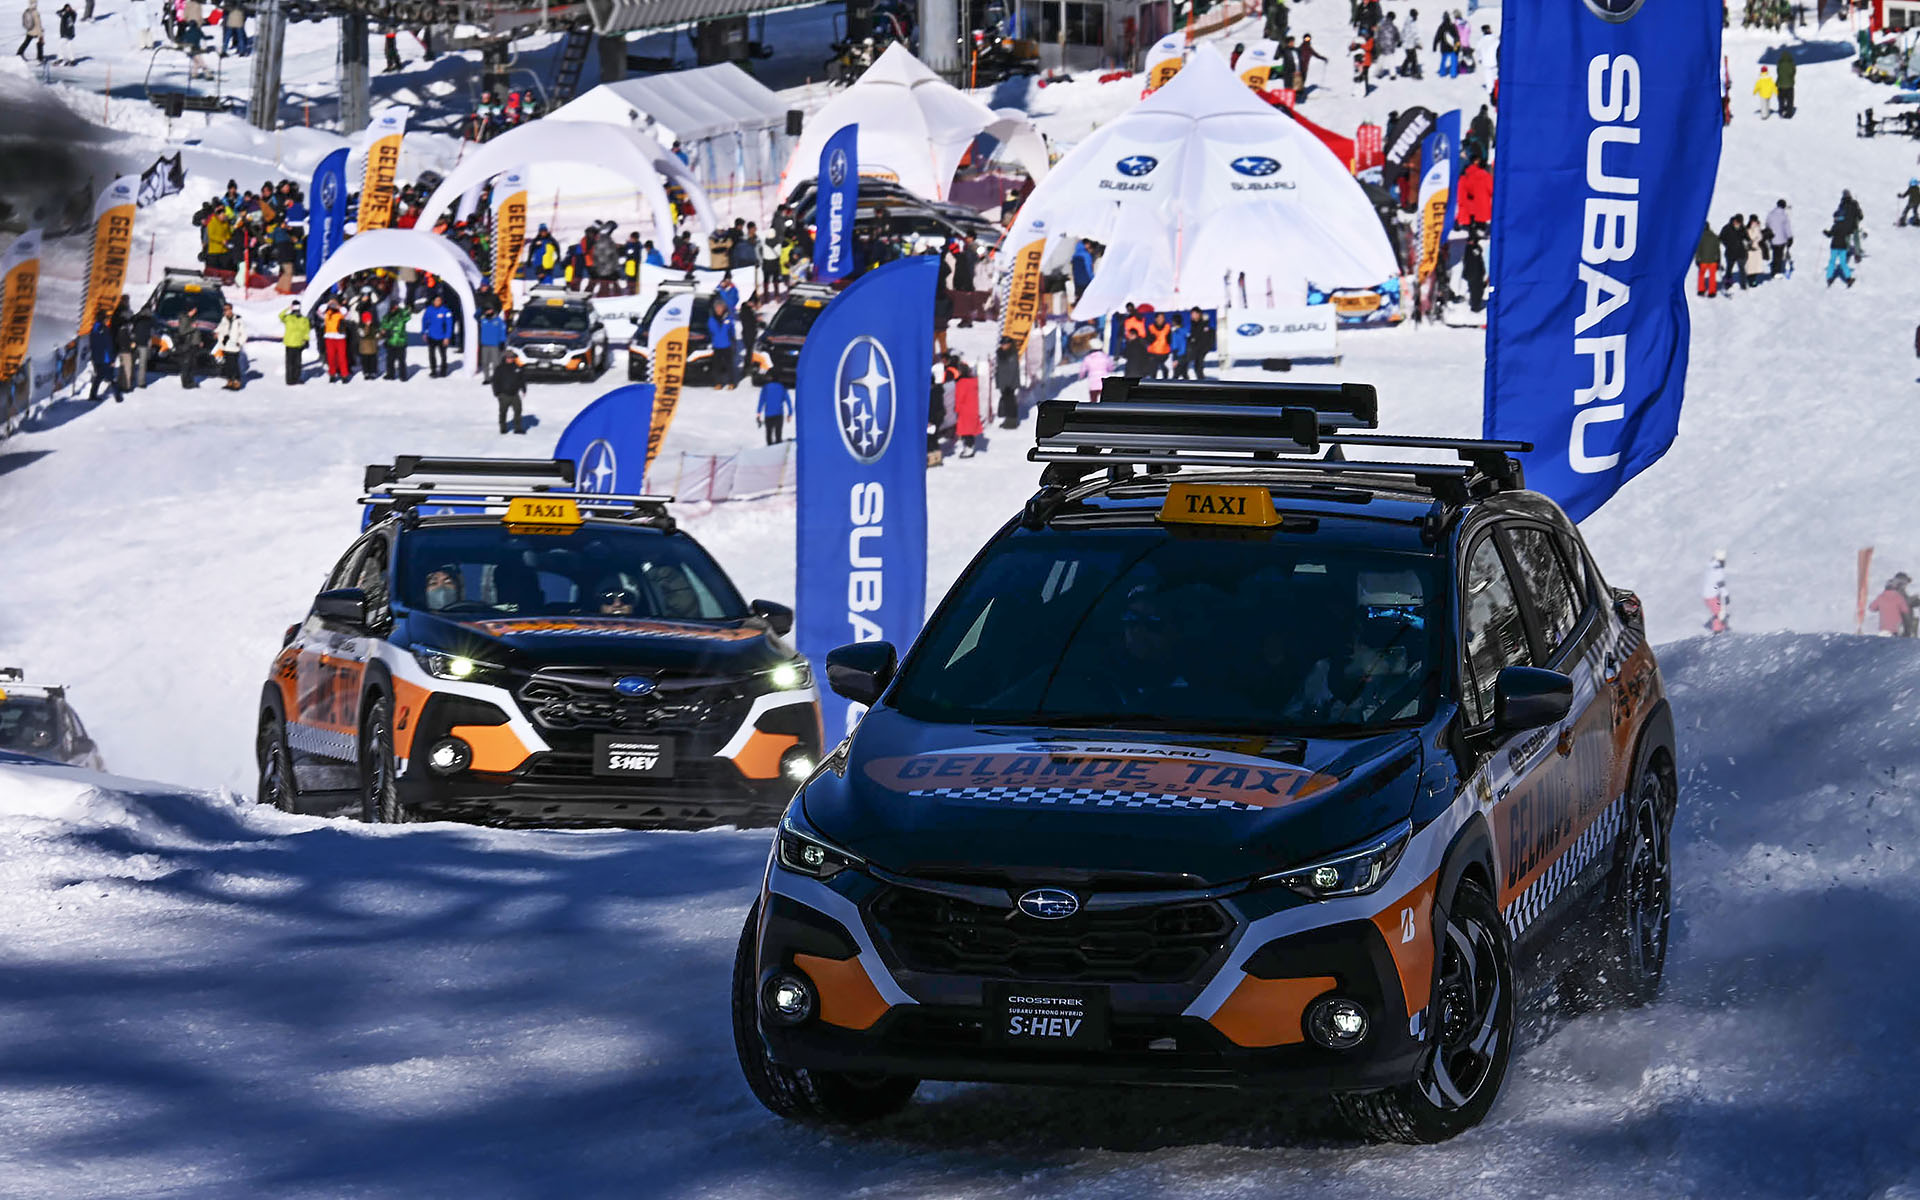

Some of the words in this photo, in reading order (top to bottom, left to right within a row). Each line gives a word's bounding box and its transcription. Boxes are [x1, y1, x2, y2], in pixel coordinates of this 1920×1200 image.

[1387, 113, 1431, 164] THULE
[370, 146, 398, 213] GELANDE
[1099, 179, 1153, 192] SUBARU
[1230, 181, 1296, 191] SUBARU
[102, 215, 130, 288] GELANDE
[827, 192, 843, 273] SUBARU
[1568, 53, 1641, 474] SUBARU
[7, 272, 35, 345] GELANDE
[1014, 251, 1041, 322] GELANDE
[523, 503, 564, 517] TAXI
[1185, 495, 1247, 515] TAXI
[846, 481, 884, 738] SUBA
[1084, 746, 1212, 758] SUBARU
[897, 756, 1160, 780] GELANDE
[1185, 763, 1311, 796] TAXI
[1008, 996, 1083, 1006] CROSSTREK
[1008, 1016, 1081, 1037] S:HEV
